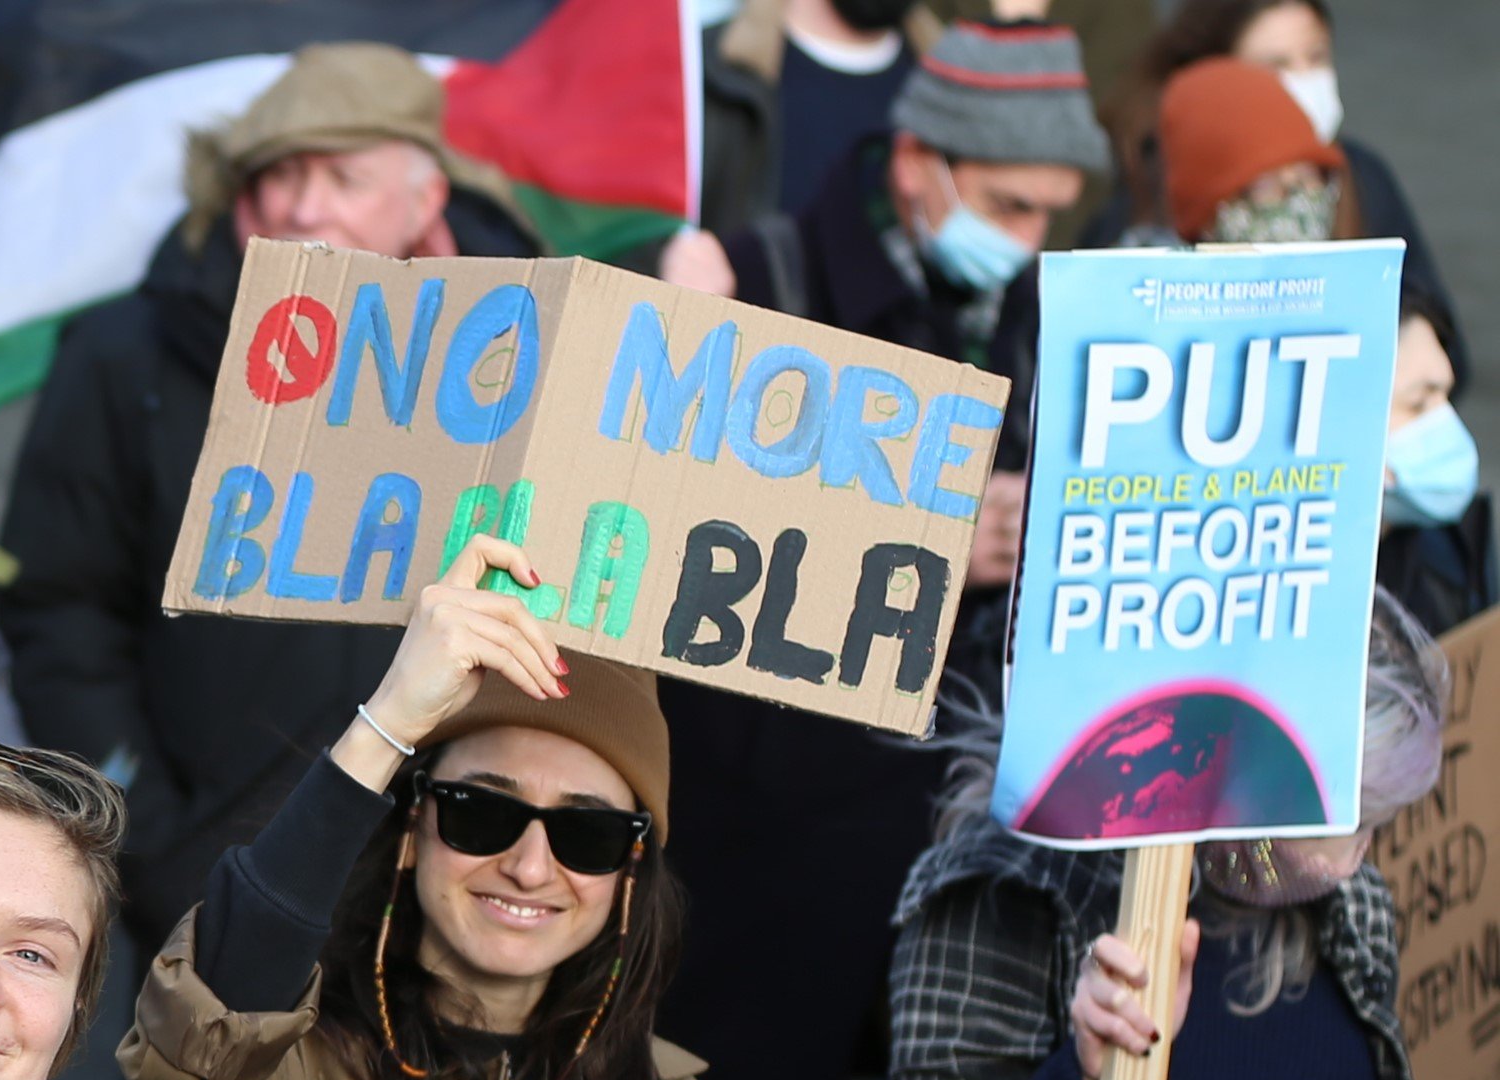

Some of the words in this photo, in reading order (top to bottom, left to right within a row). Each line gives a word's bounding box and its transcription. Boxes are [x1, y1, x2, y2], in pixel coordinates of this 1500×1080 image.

[1164, 281, 1221, 300] PEOPLE
[1223, 280, 1276, 299] BEFORE
[1278, 278, 1326, 297] PROFIT
[598, 301, 1003, 521] MORE
[1079, 334, 1361, 469] PUT
[1064, 474, 1194, 506] PEOPLE
[1203, 473, 1223, 501] &
[1232, 463, 1348, 499] PLANET
[193, 464, 423, 605] BLA
[662, 519, 951, 694] BLA
[1057, 501, 1337, 577] BEFORE
[1050, 570, 1329, 654] PROFIT
